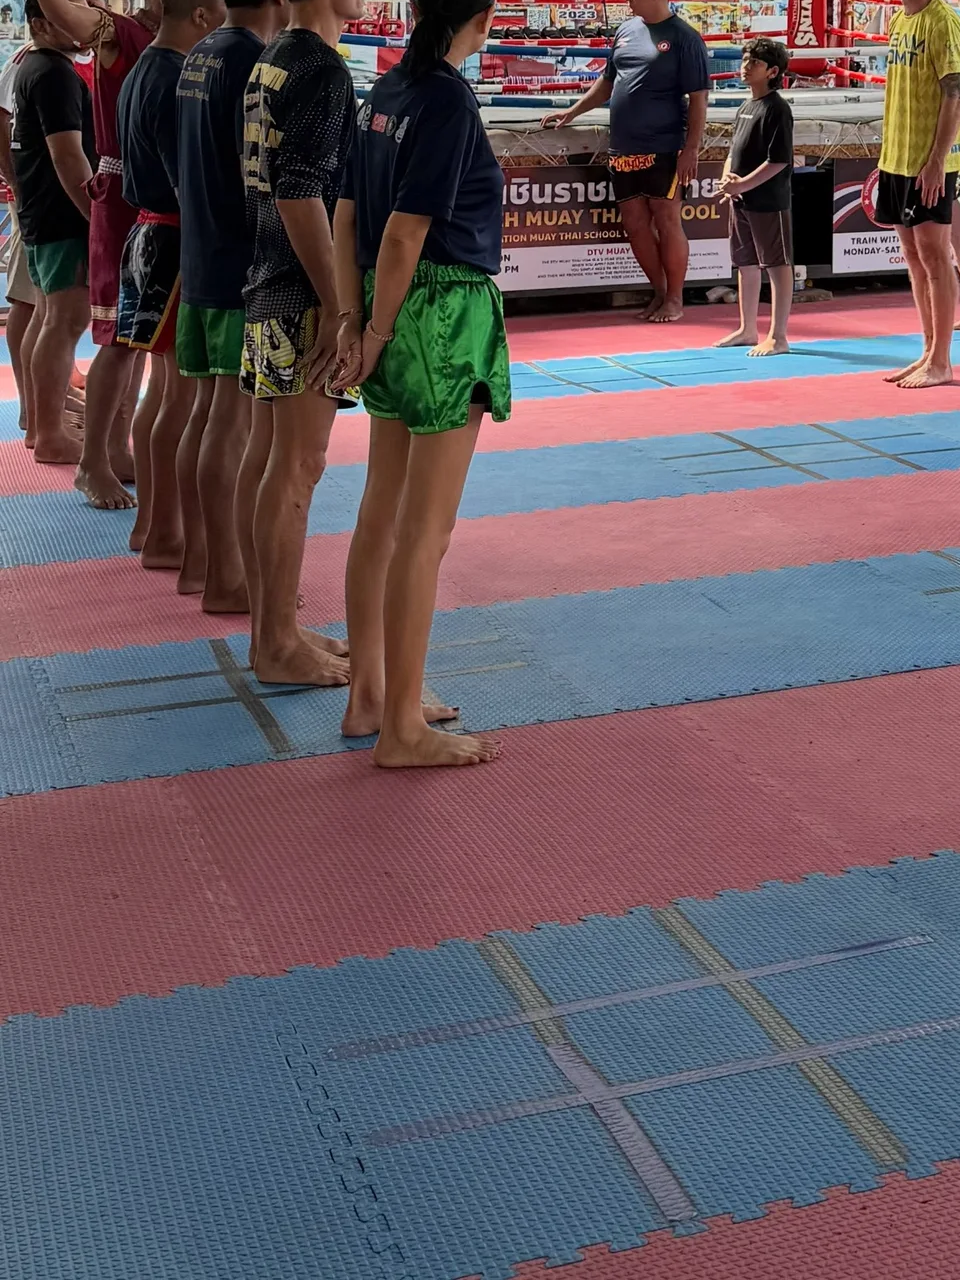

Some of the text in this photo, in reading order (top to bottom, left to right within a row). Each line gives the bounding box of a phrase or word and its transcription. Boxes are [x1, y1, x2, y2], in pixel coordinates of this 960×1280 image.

[558, 10, 596, 19] 2023
[890, 32, 926, 54] EAM
[525, 209, 584, 227] MUAY
[681, 204, 721, 221] OOL
[529, 232, 557, 242] MUAY
[559, 231, 582, 241] THAI
[583, 229, 622, 239] SCHOOL
[851, 237, 878, 245] TRAIN
[587, 246, 631, 256] DTV MUAY
[504, 264, 519, 274] PM
